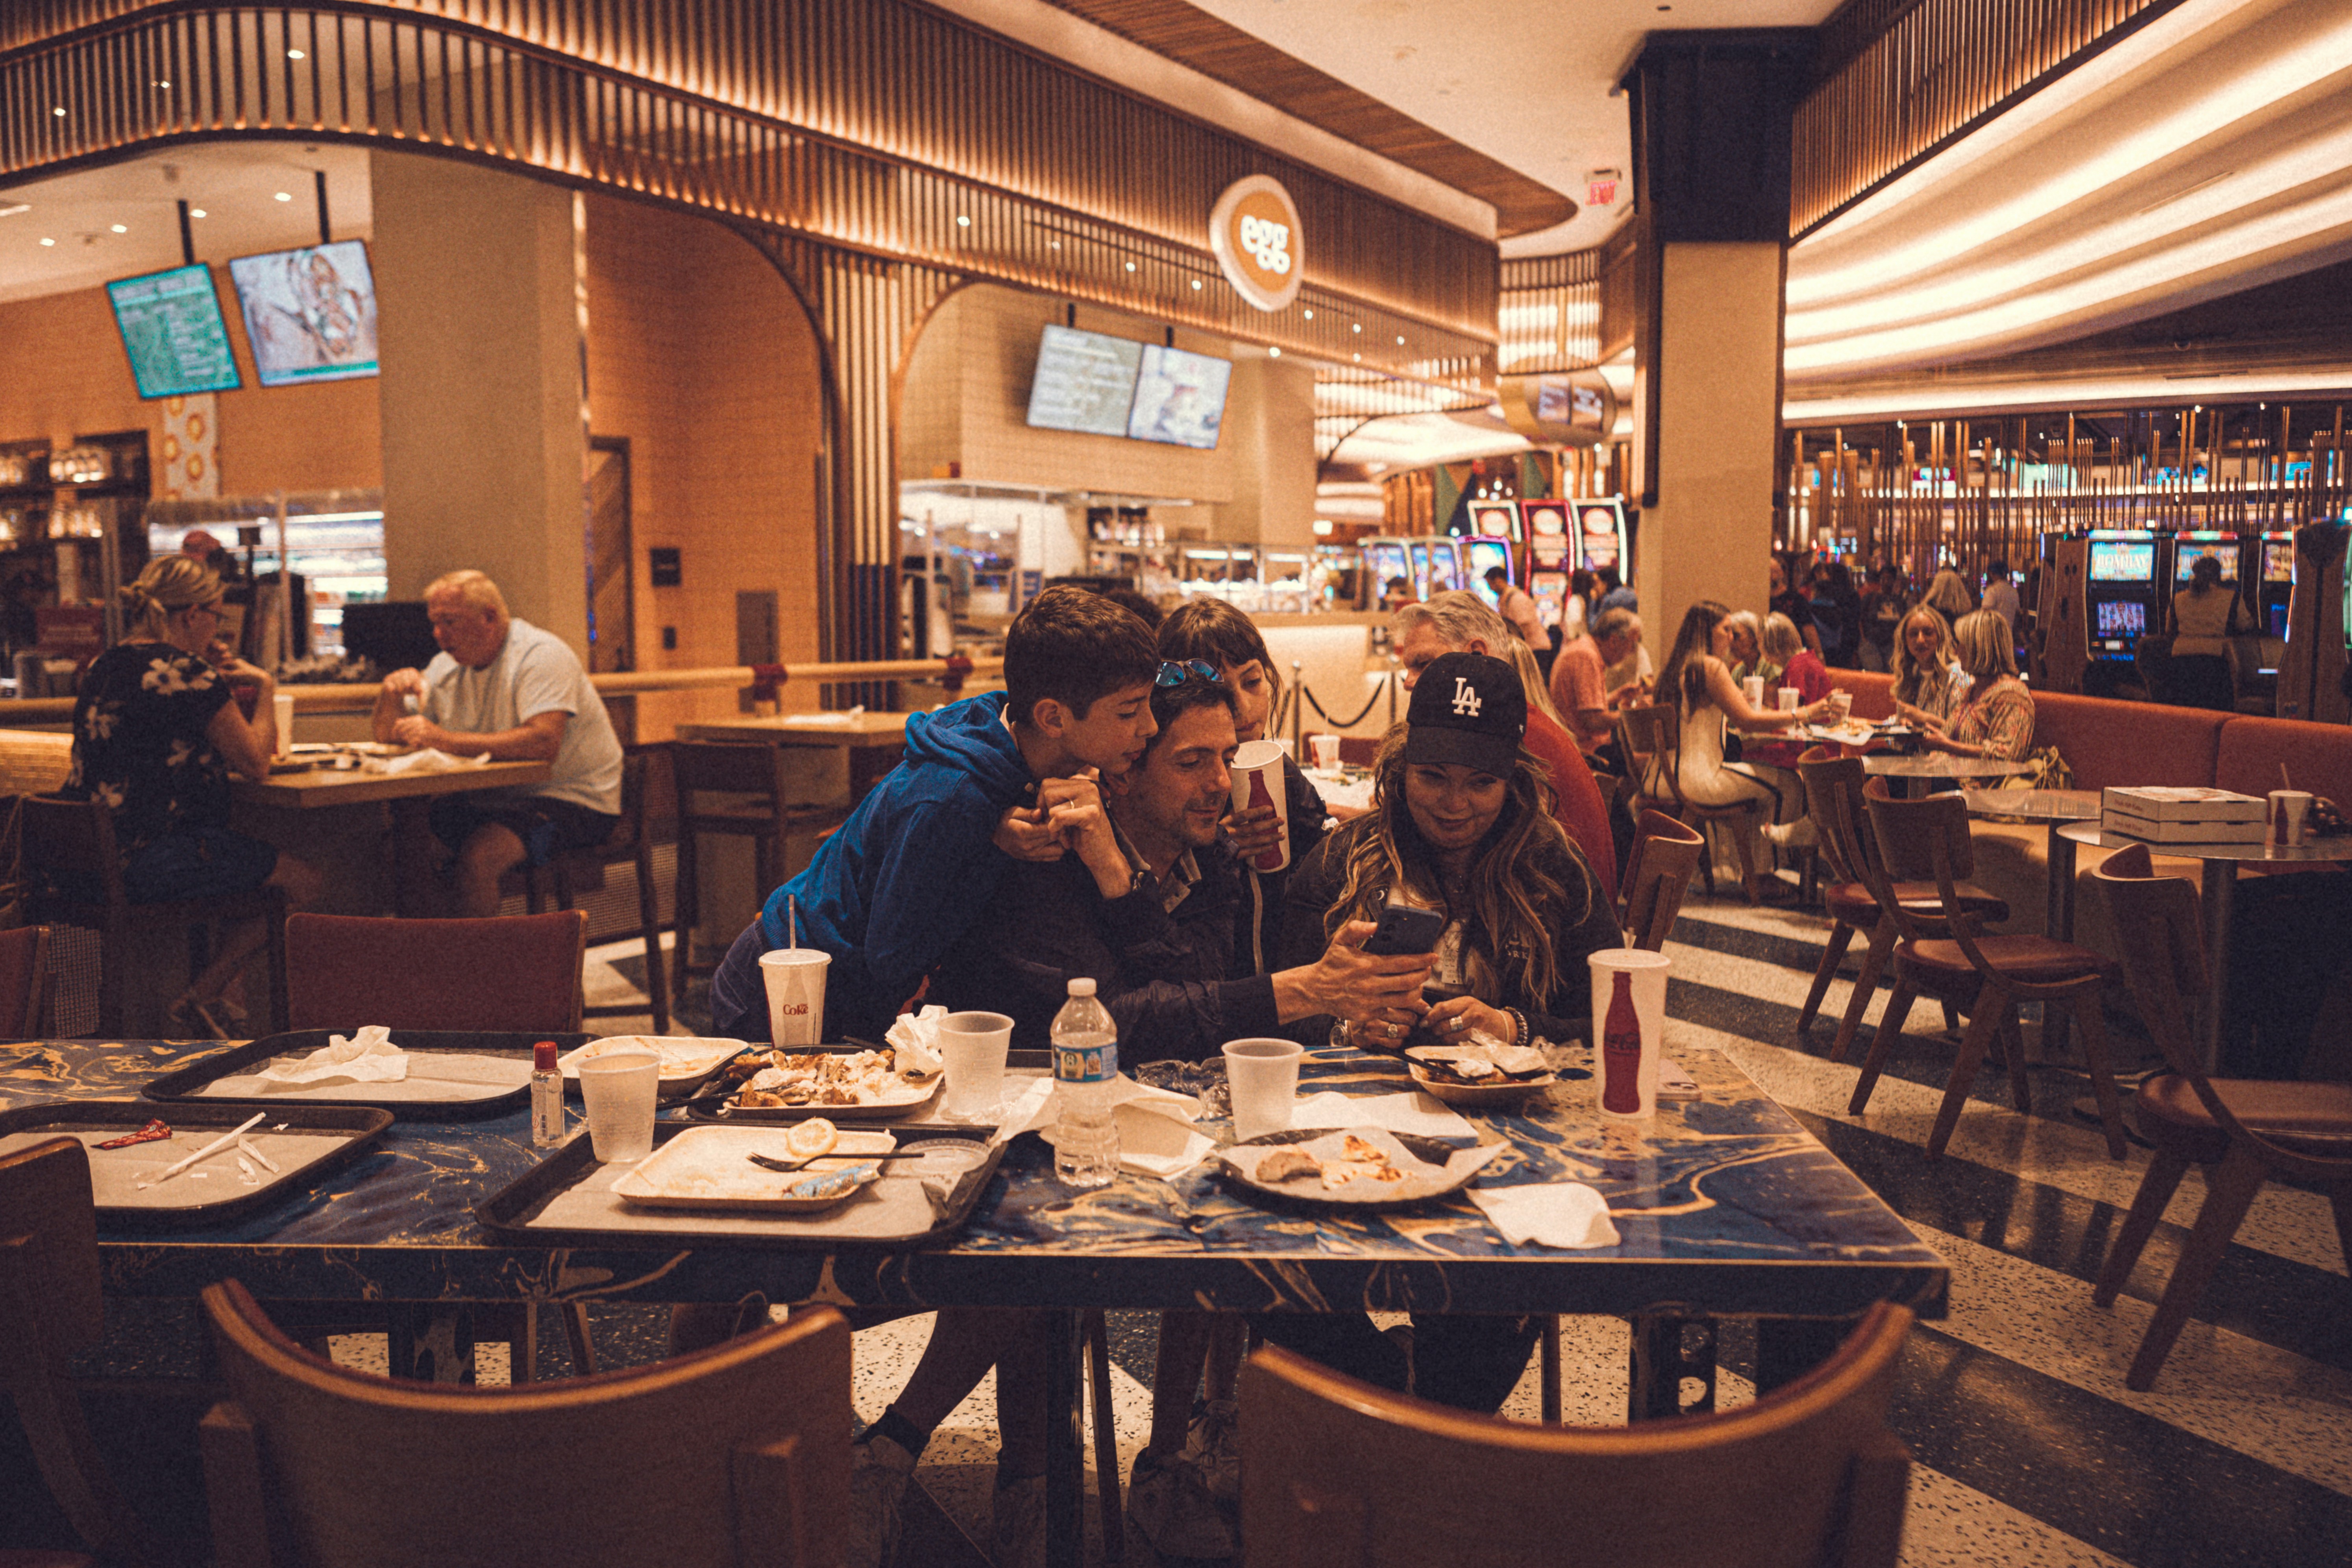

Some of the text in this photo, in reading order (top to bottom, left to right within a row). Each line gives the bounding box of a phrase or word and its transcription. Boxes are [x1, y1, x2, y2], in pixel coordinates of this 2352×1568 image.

[1240, 214, 1291, 274] egg
[1452, 677, 1482, 717] LA
[783, 1004, 809, 1015] Coke
